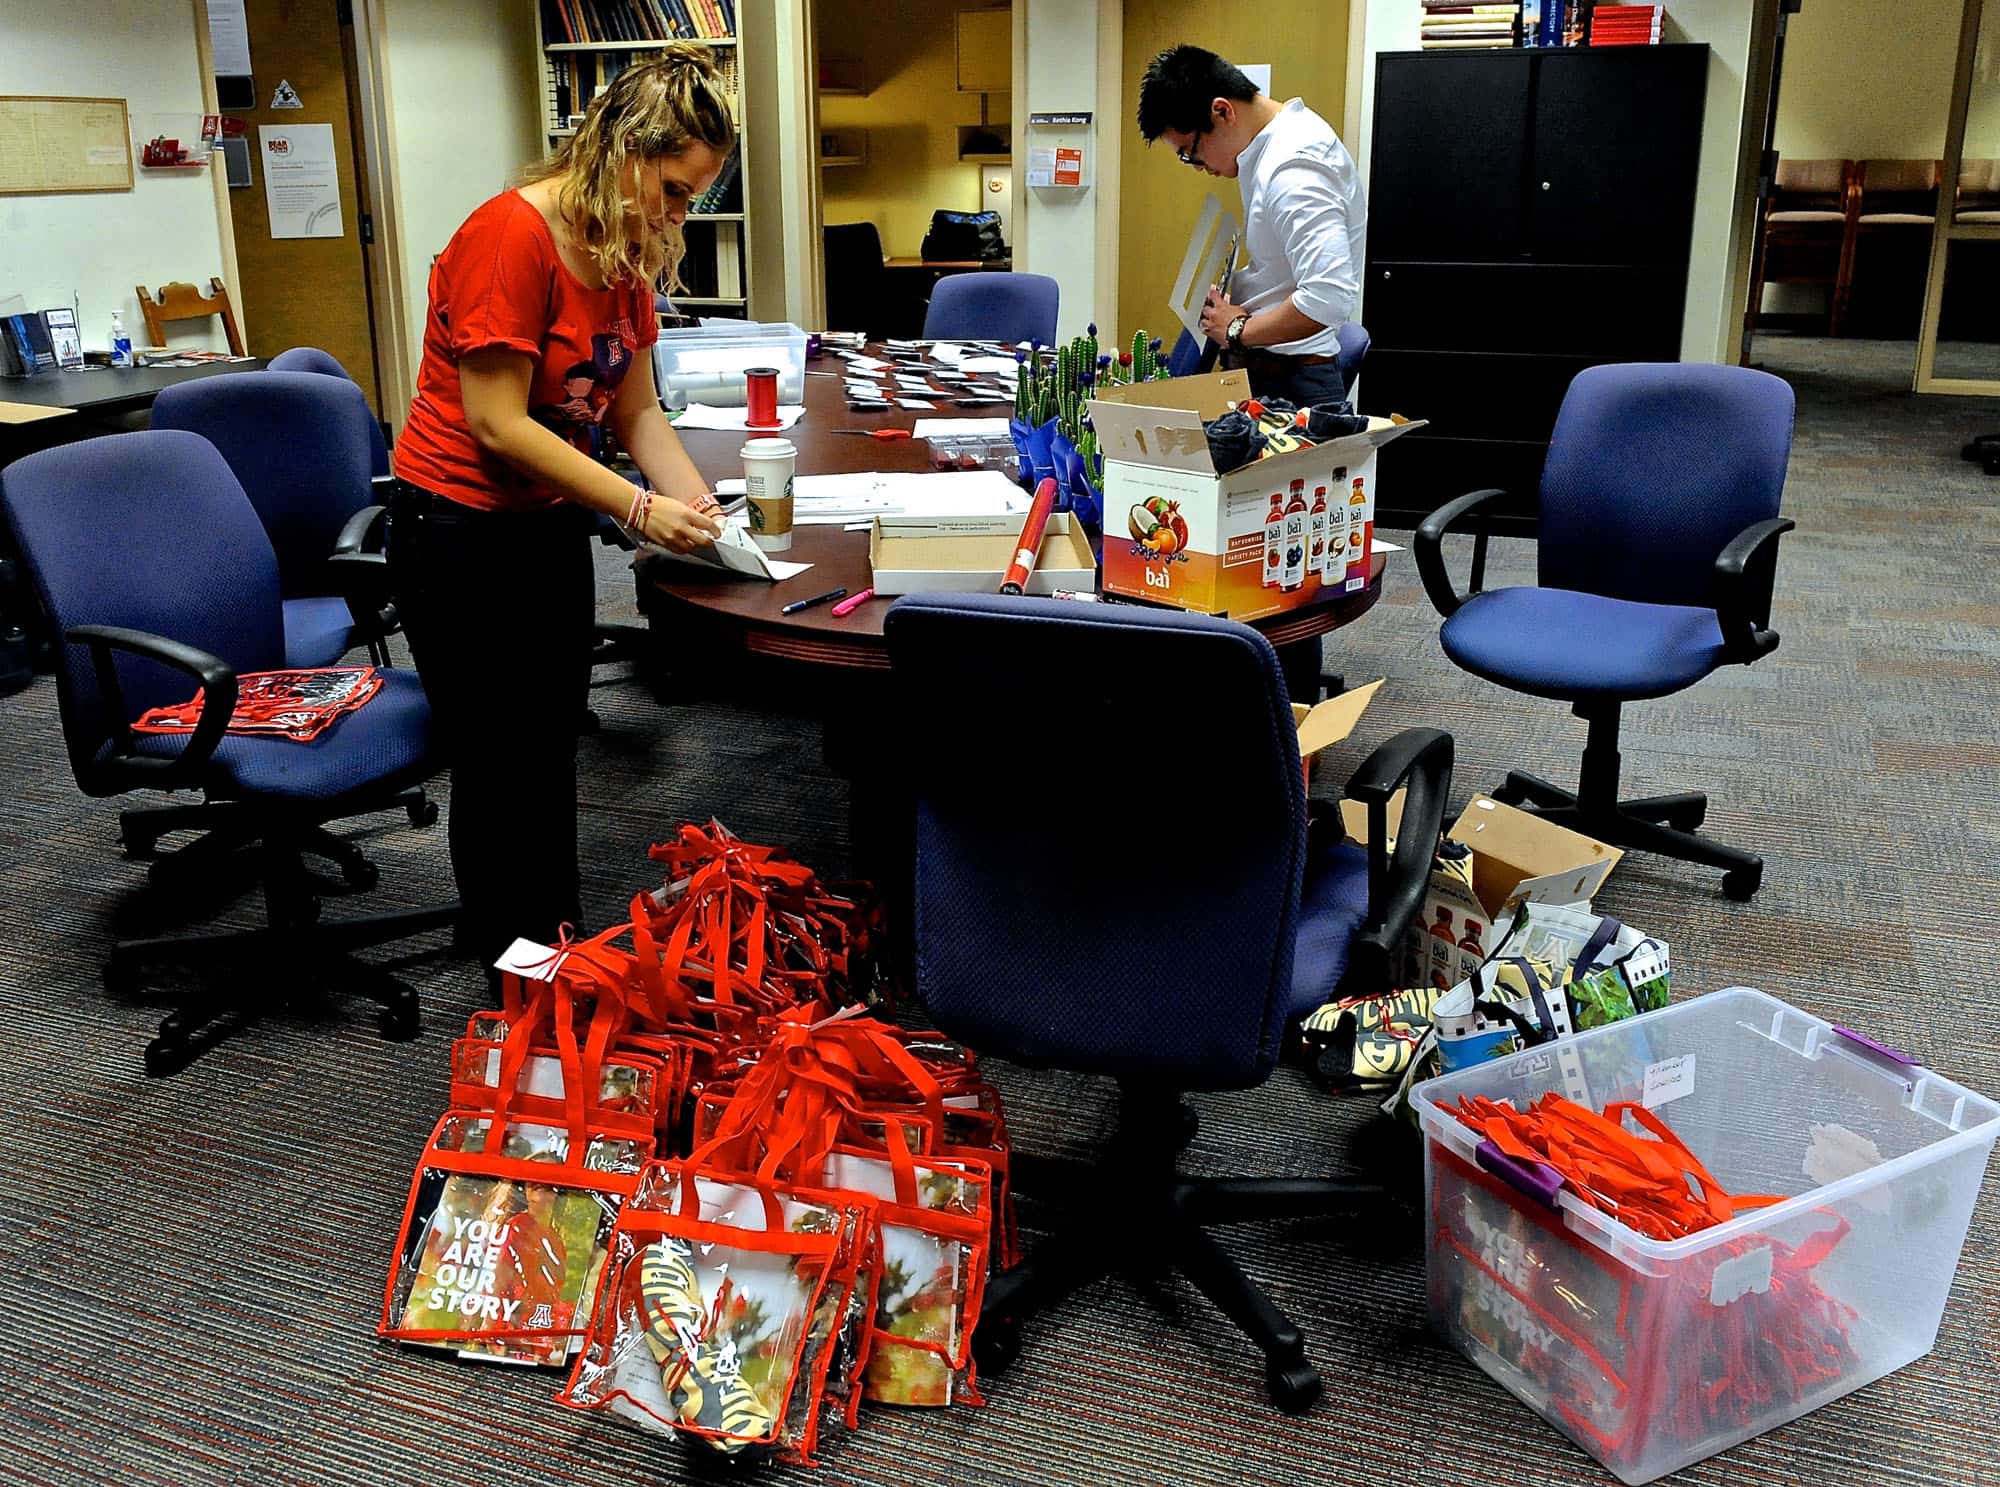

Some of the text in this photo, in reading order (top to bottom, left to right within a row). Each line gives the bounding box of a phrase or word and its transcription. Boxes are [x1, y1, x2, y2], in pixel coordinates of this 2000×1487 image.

[1312, 516, 1324, 531] bai
[1329, 507, 1344, 525] bai
[1350, 508, 1362, 522] bai
[1268, 525, 1281, 540] bai
[1287, 518, 1302, 535] bai
[1145, 566, 1170, 589] bai
[453, 1216, 511, 1246] YOU
[441, 1241, 501, 1270] ARE
[436, 1264, 496, 1294] OUR
[427, 1287, 520, 1322] STORY
